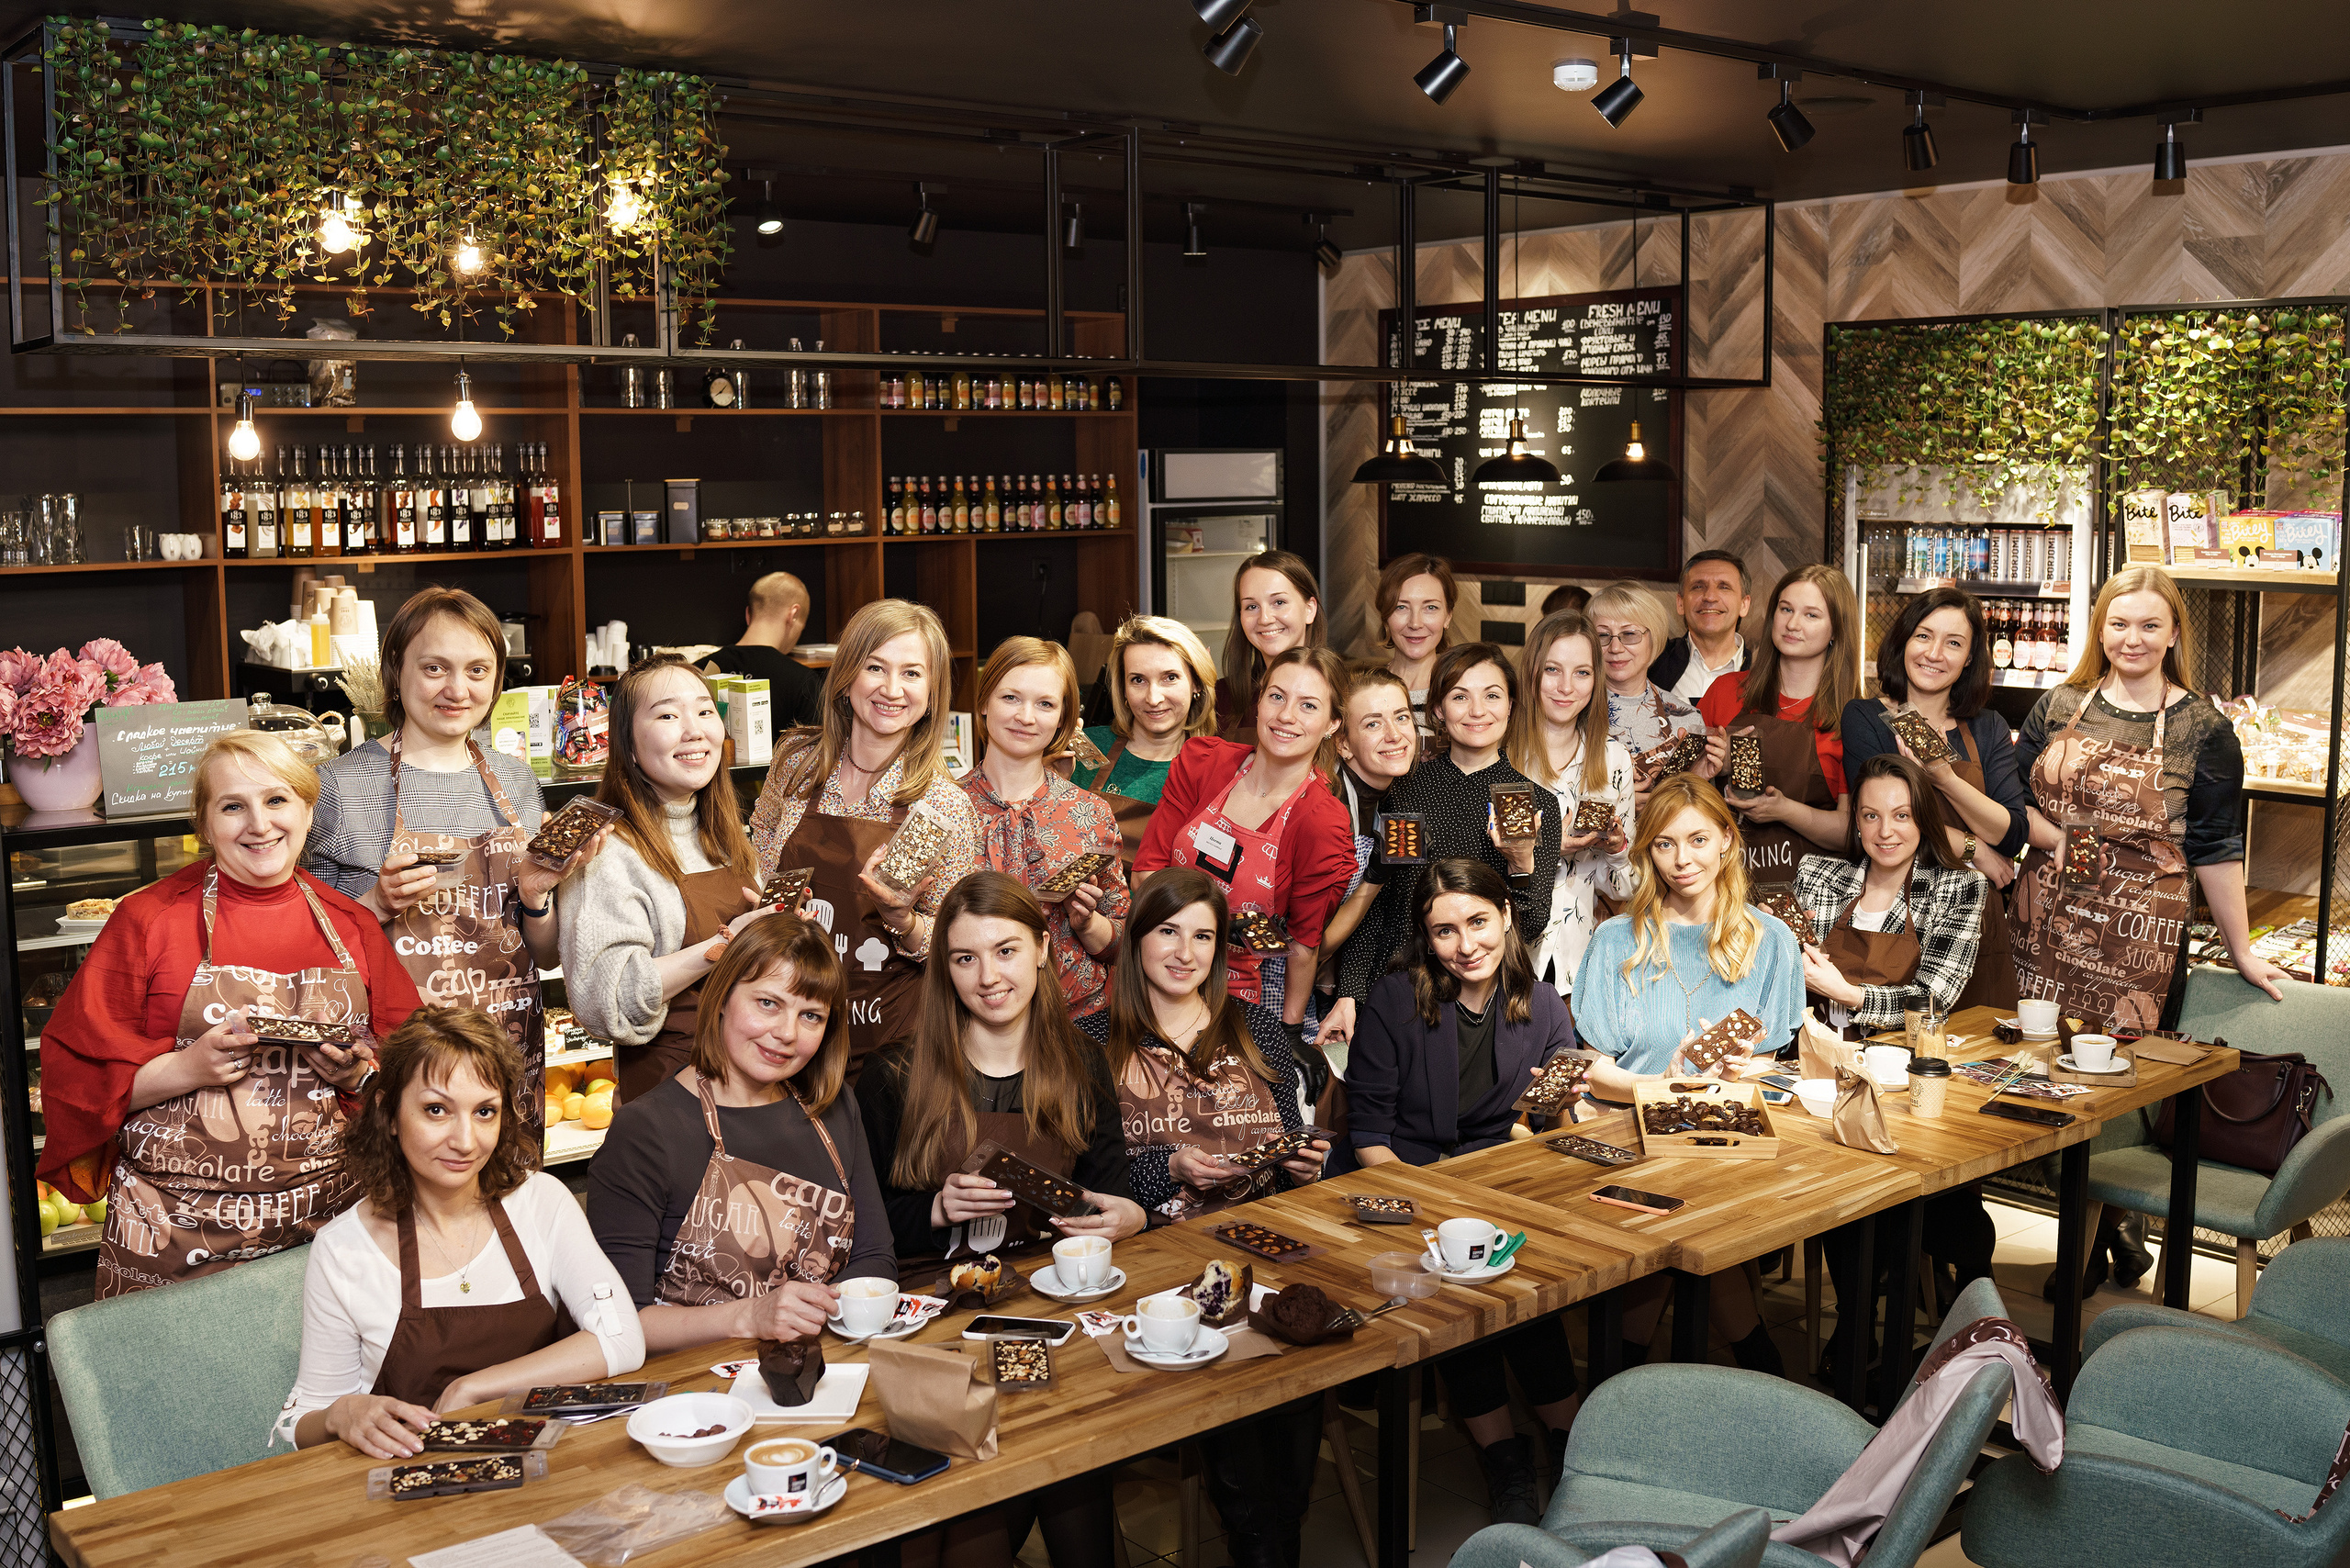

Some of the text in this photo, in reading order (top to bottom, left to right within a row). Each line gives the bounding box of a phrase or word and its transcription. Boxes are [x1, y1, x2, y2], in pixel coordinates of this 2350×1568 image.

[1525, 308, 1557, 323] MENU
[1588, 304, 1623, 319] FRESH
[1434, 317, 1461, 330] MENU
[1609, 353, 1643, 364] ПРЯМОО
[2125, 504, 2157, 521] Bite
[2230, 522, 2272, 543] Bitey
[2286, 523, 2328, 546] Bitey
[1991, 536, 2000, 578] BORJOMI
[2011, 536, 2020, 578] BORJOMI
[2047, 537, 2055, 580] BORJOMI
[159, 761, 188, 778] 215
[2098, 763, 2145, 778] cap
[111, 788, 146, 806] Скидка
[2092, 808, 2164, 833] chocolate
[2065, 904, 2110, 924] cap
[2117, 911, 2185, 947] COFFEE
[395, 935, 478, 956] Coffee
[2054, 951, 2127, 979] chocolate
[2121, 946, 2175, 974] SUGAR
[426, 967, 486, 1006] cap
[487, 996, 532, 1014] cap
[245, 1079, 286, 1107] latte
[1213, 1109, 1282, 1127] chocolate
[138, 1143, 276, 1183] chocolate
[216, 1182, 321, 1232] COFFEE
[770, 1171, 846, 1226] cap
[778, 1208, 812, 1239] latte
[106, 1213, 161, 1258] LATTE
[186, 1244, 285, 1267] Coffee
